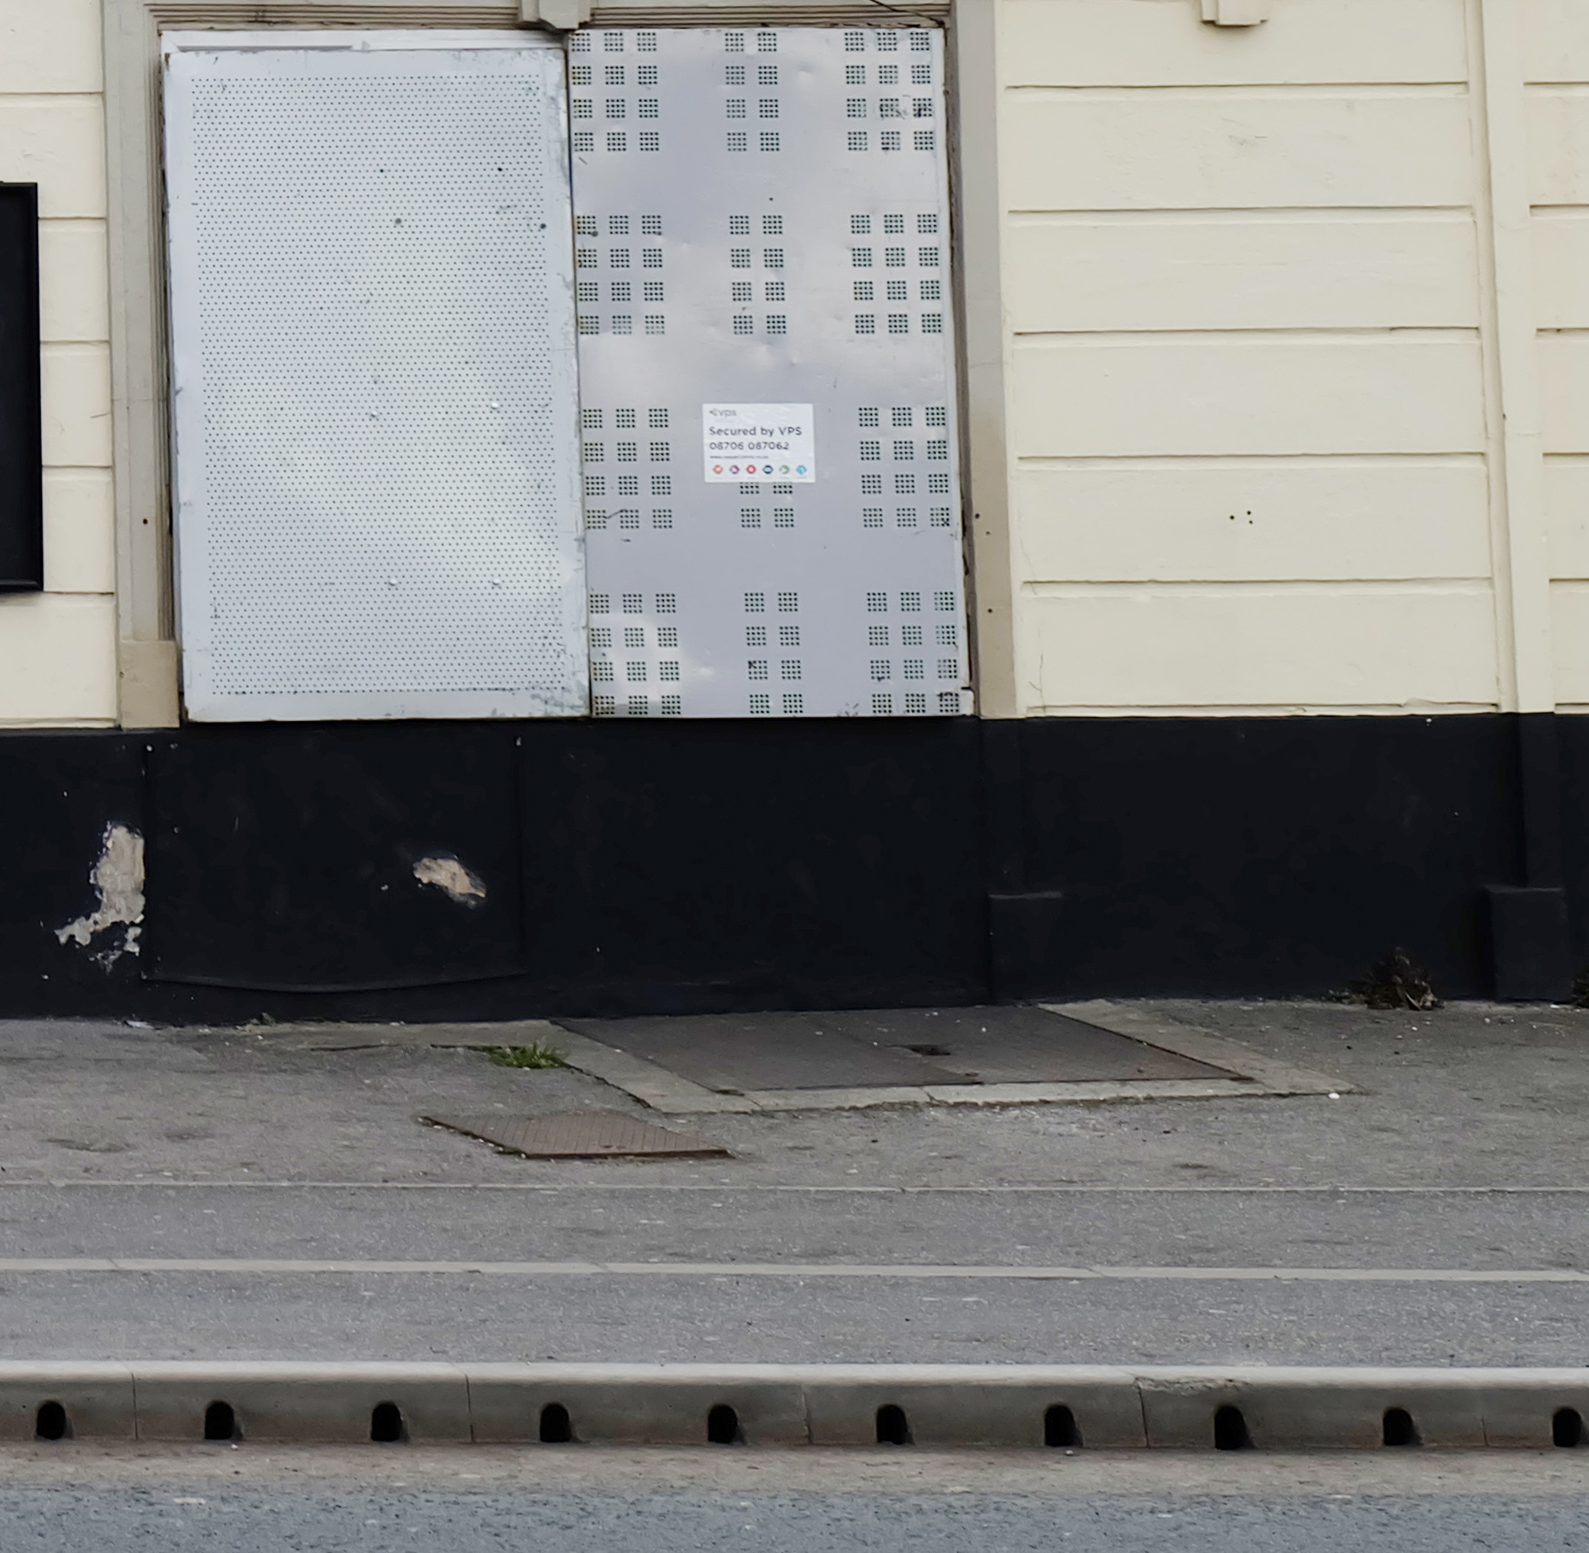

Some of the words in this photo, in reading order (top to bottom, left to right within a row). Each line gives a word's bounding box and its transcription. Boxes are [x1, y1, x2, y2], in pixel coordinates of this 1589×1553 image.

[709, 426, 756, 436] Secured
[760, 426, 775, 437] by
[778, 426, 802, 436] VPS
[709, 441, 744, 450] 08706
[747, 441, 790, 450] 087062
